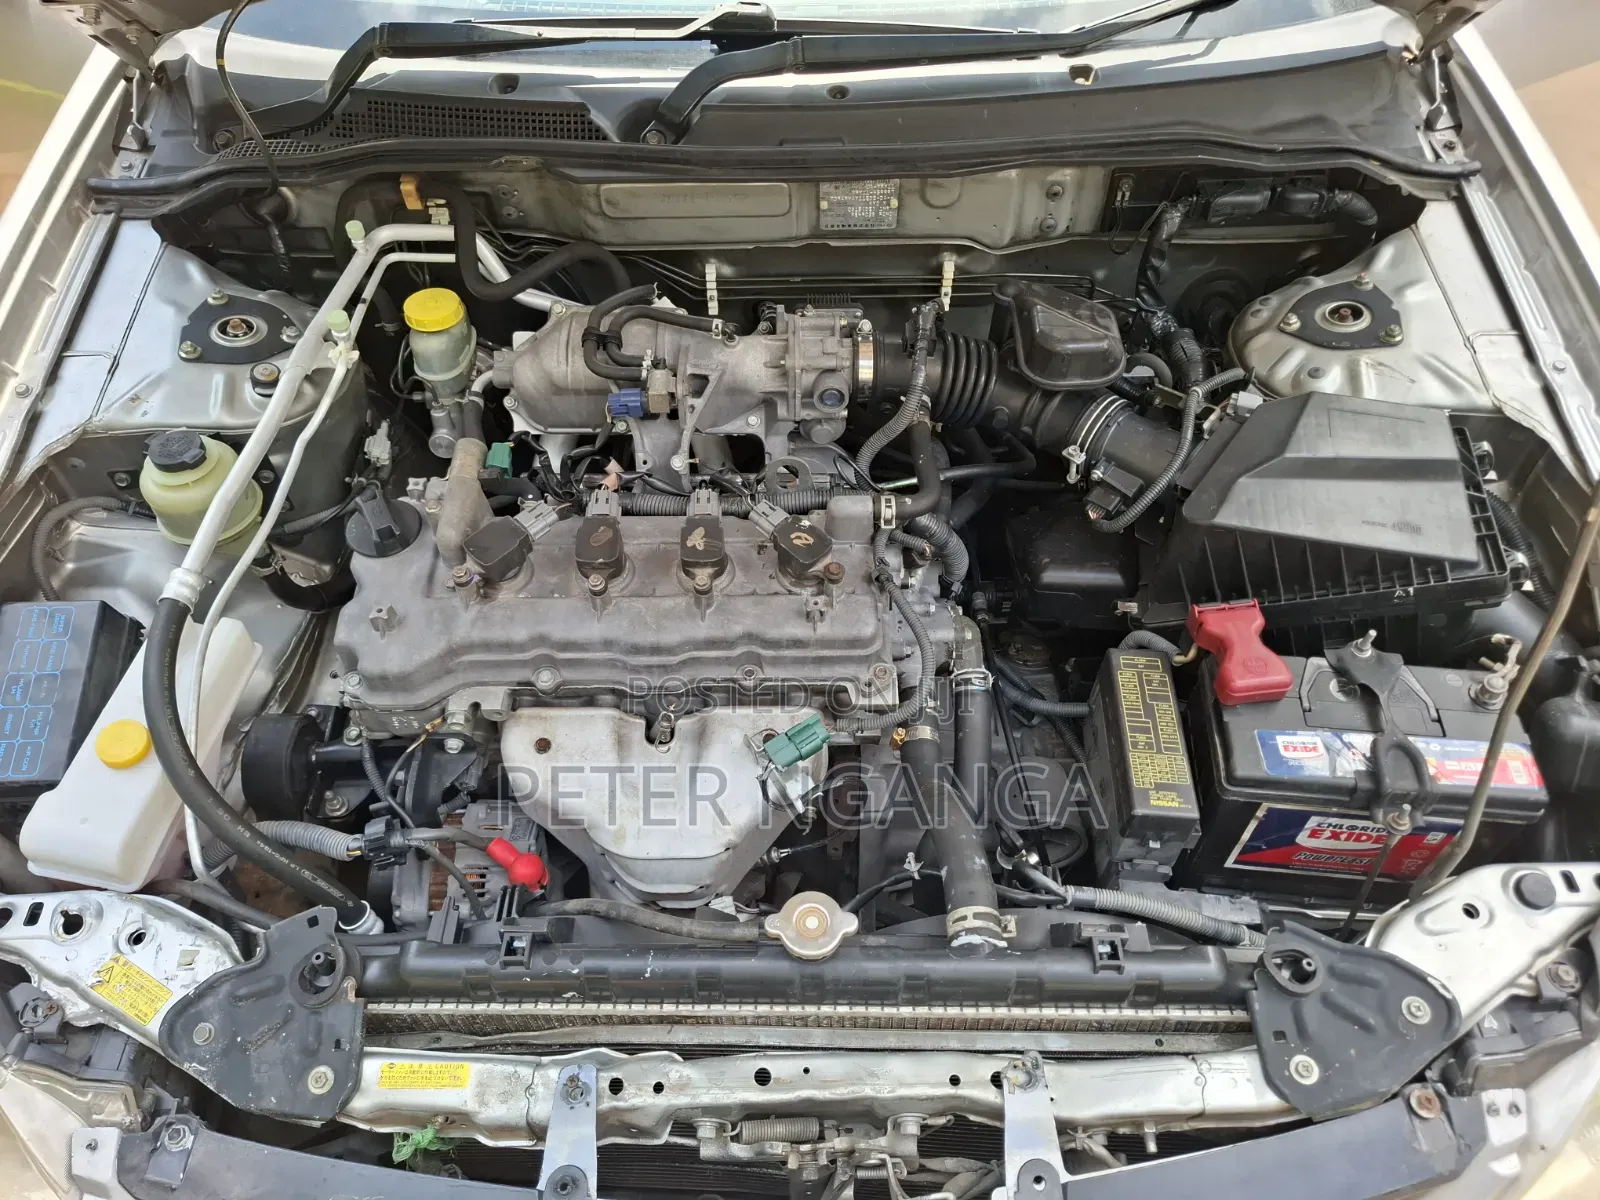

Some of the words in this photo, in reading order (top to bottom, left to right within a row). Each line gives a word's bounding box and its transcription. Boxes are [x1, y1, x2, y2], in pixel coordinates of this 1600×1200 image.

[1283, 745, 1320, 753] EXIDE
[1150, 799, 1179, 808] NISSAN
[1316, 822, 1389, 833] CHLORID
[1307, 828, 1389, 845] EXIDE
